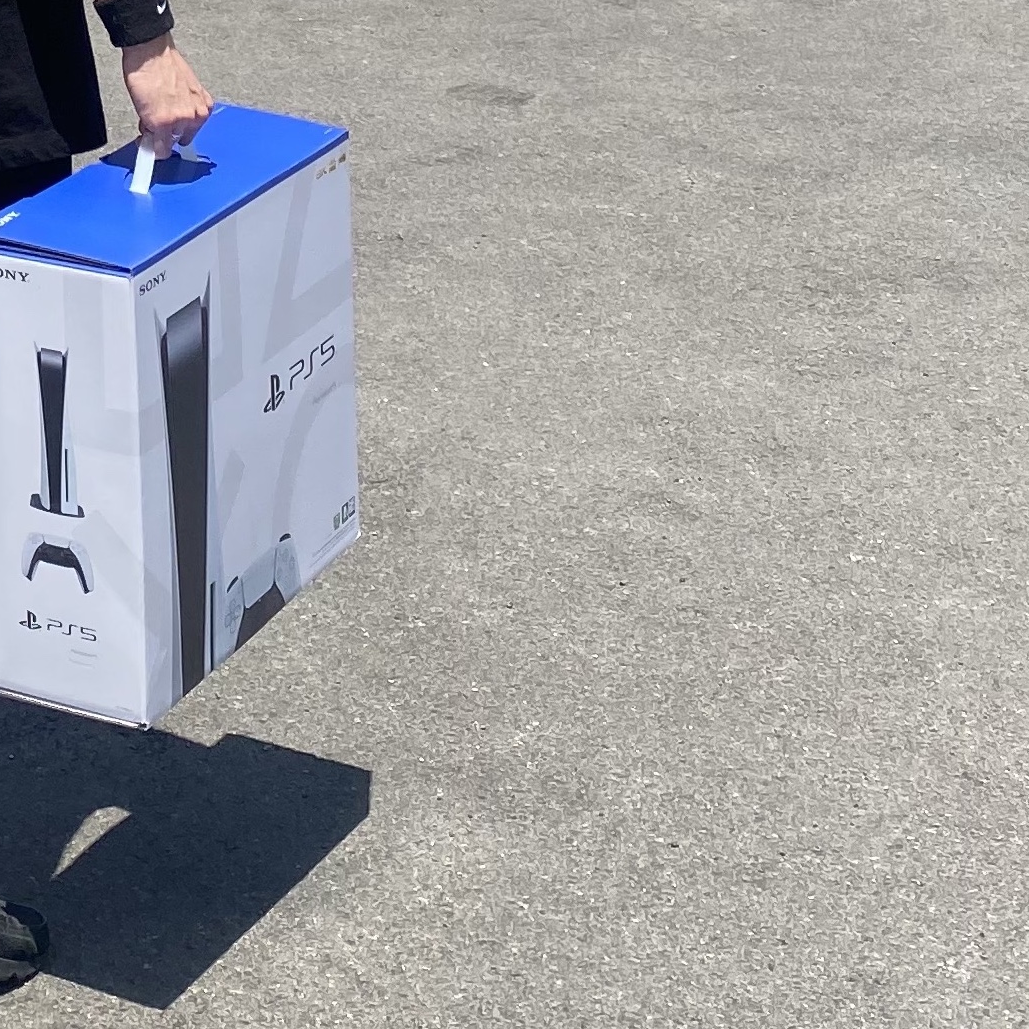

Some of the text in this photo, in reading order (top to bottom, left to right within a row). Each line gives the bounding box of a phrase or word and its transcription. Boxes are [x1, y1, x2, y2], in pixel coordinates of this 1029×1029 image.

[139, 271, 167, 297] SONY
[289, 334, 335, 390] PS5
[46, 617, 97, 642] PS5
